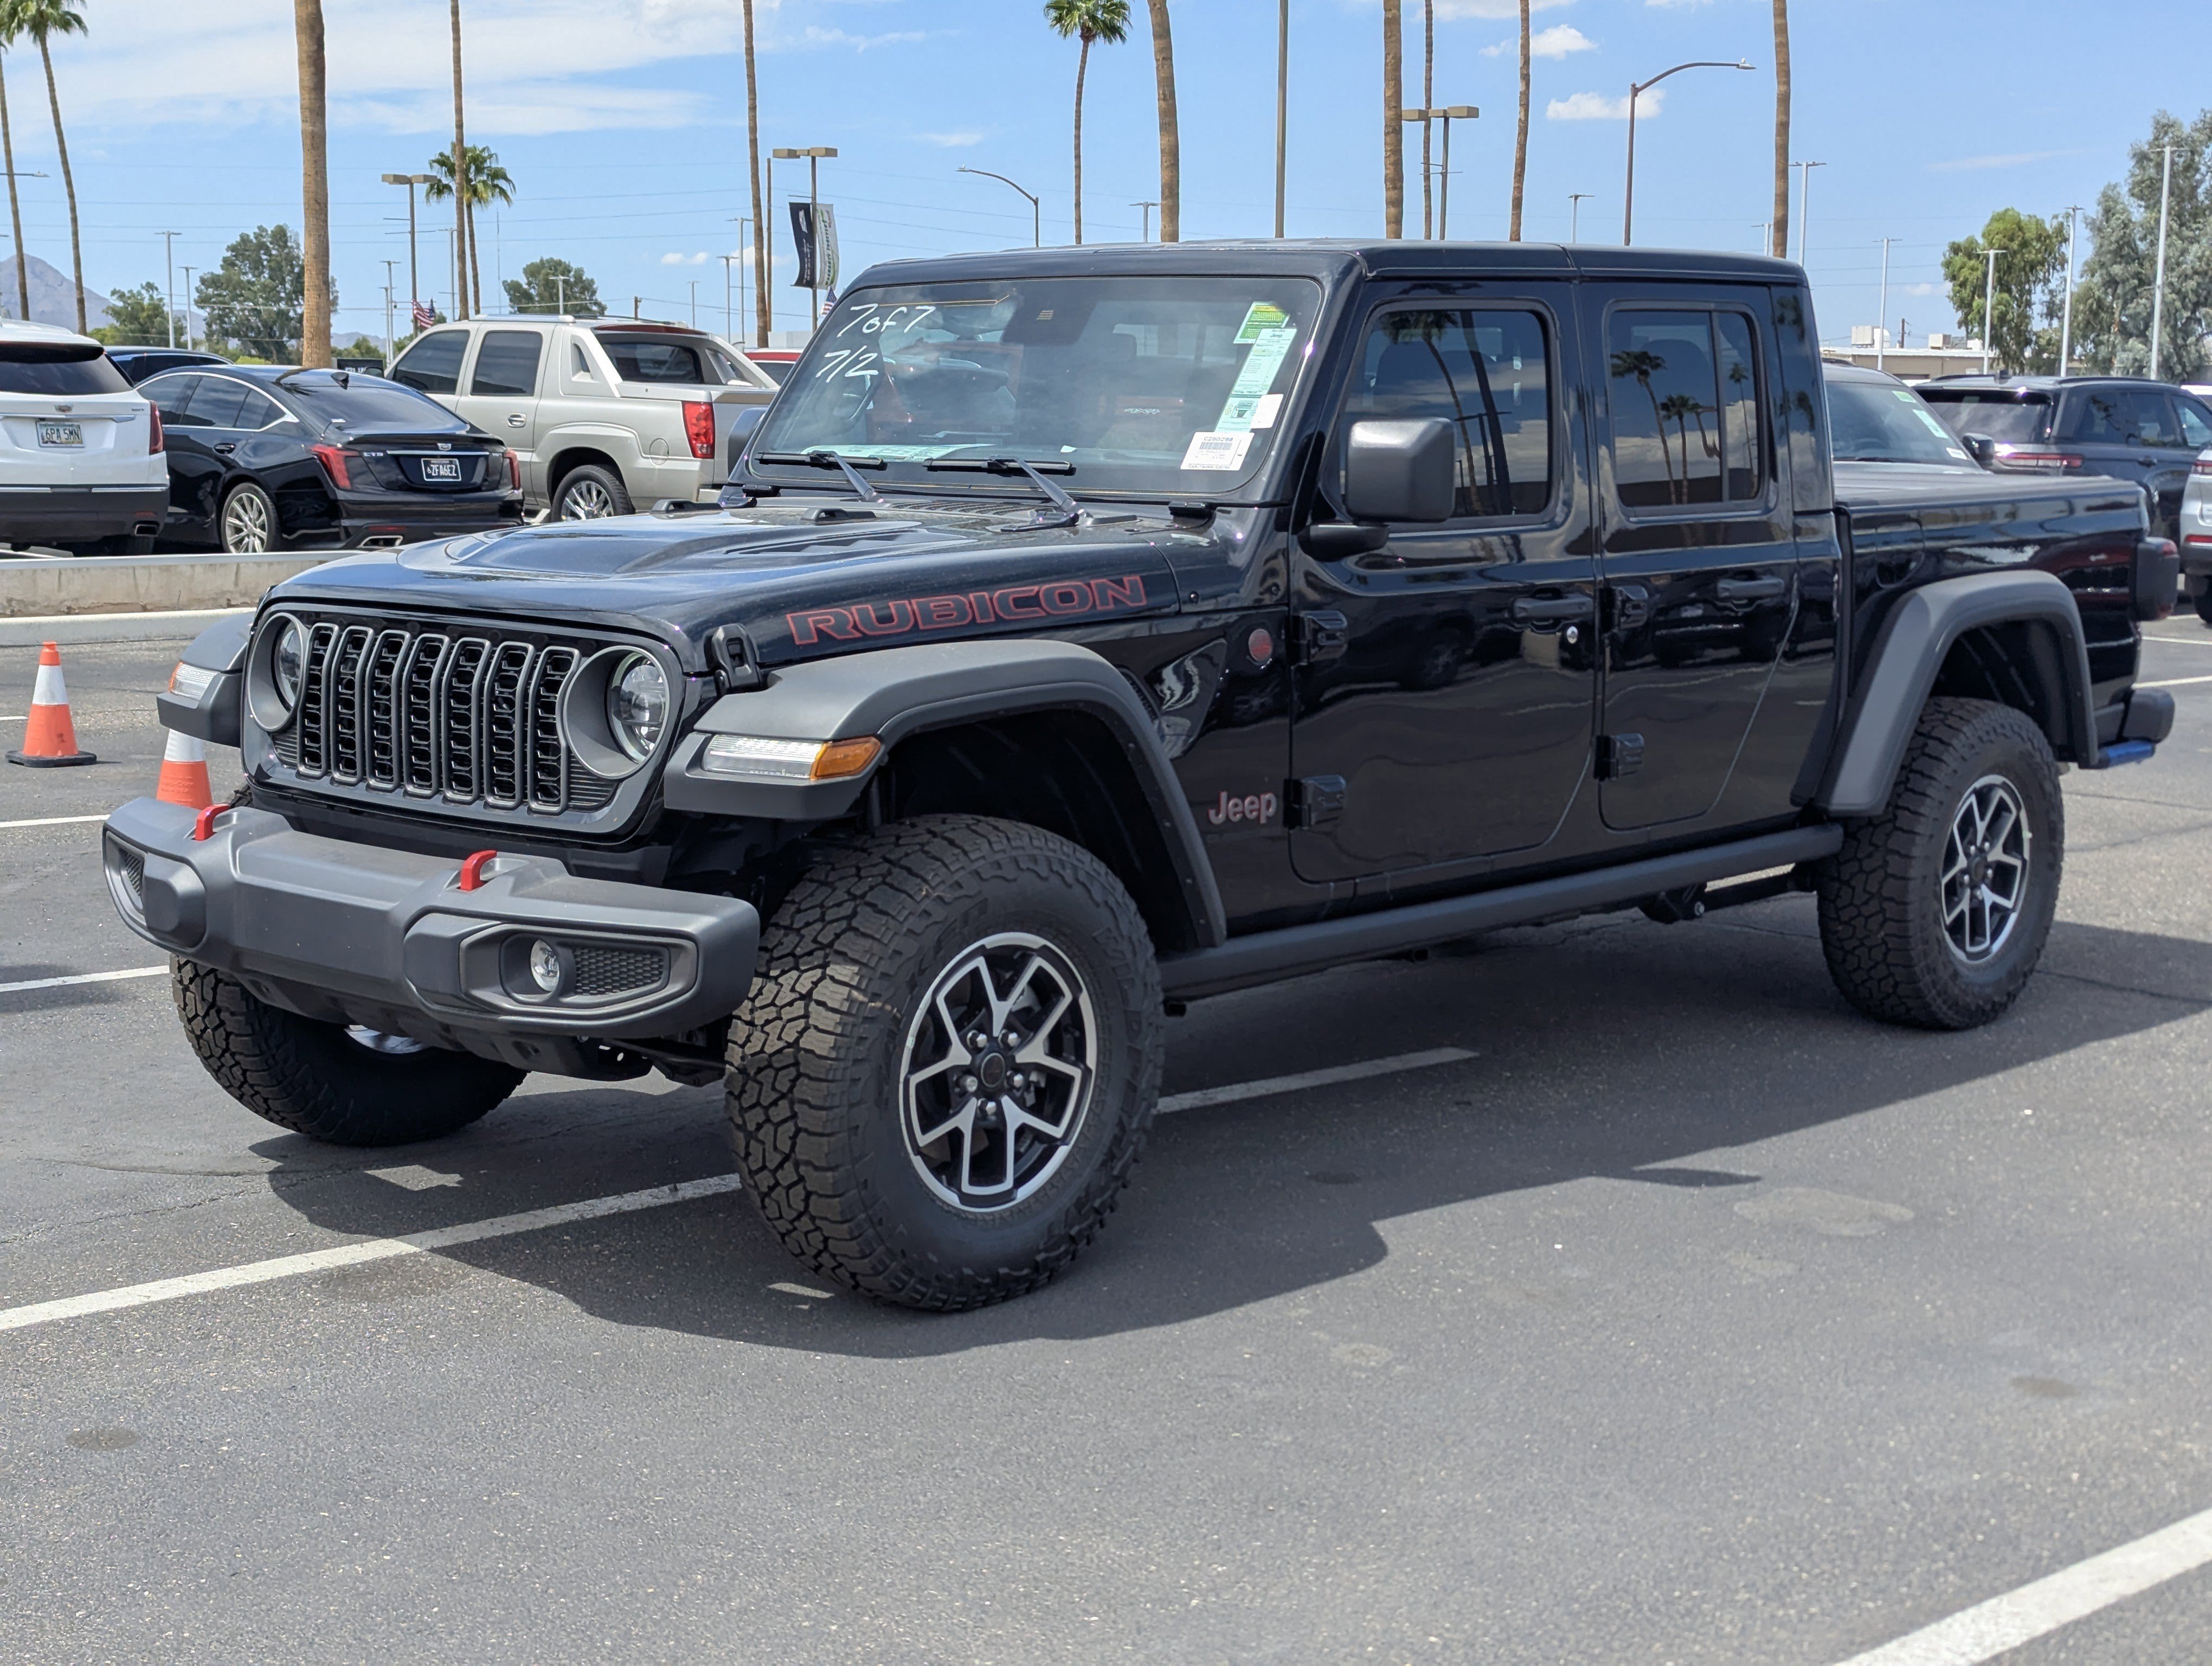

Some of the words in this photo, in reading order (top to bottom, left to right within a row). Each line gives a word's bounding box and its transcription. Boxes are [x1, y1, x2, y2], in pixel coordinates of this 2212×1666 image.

[837, 304, 878, 337] 7
[863, 306, 907, 333] of
[904, 305, 936, 333] 7
[815, 345, 879, 382] 7/2
[786, 575, 1147, 645] RUBICON
[1208, 791, 1277, 824] Jeep
